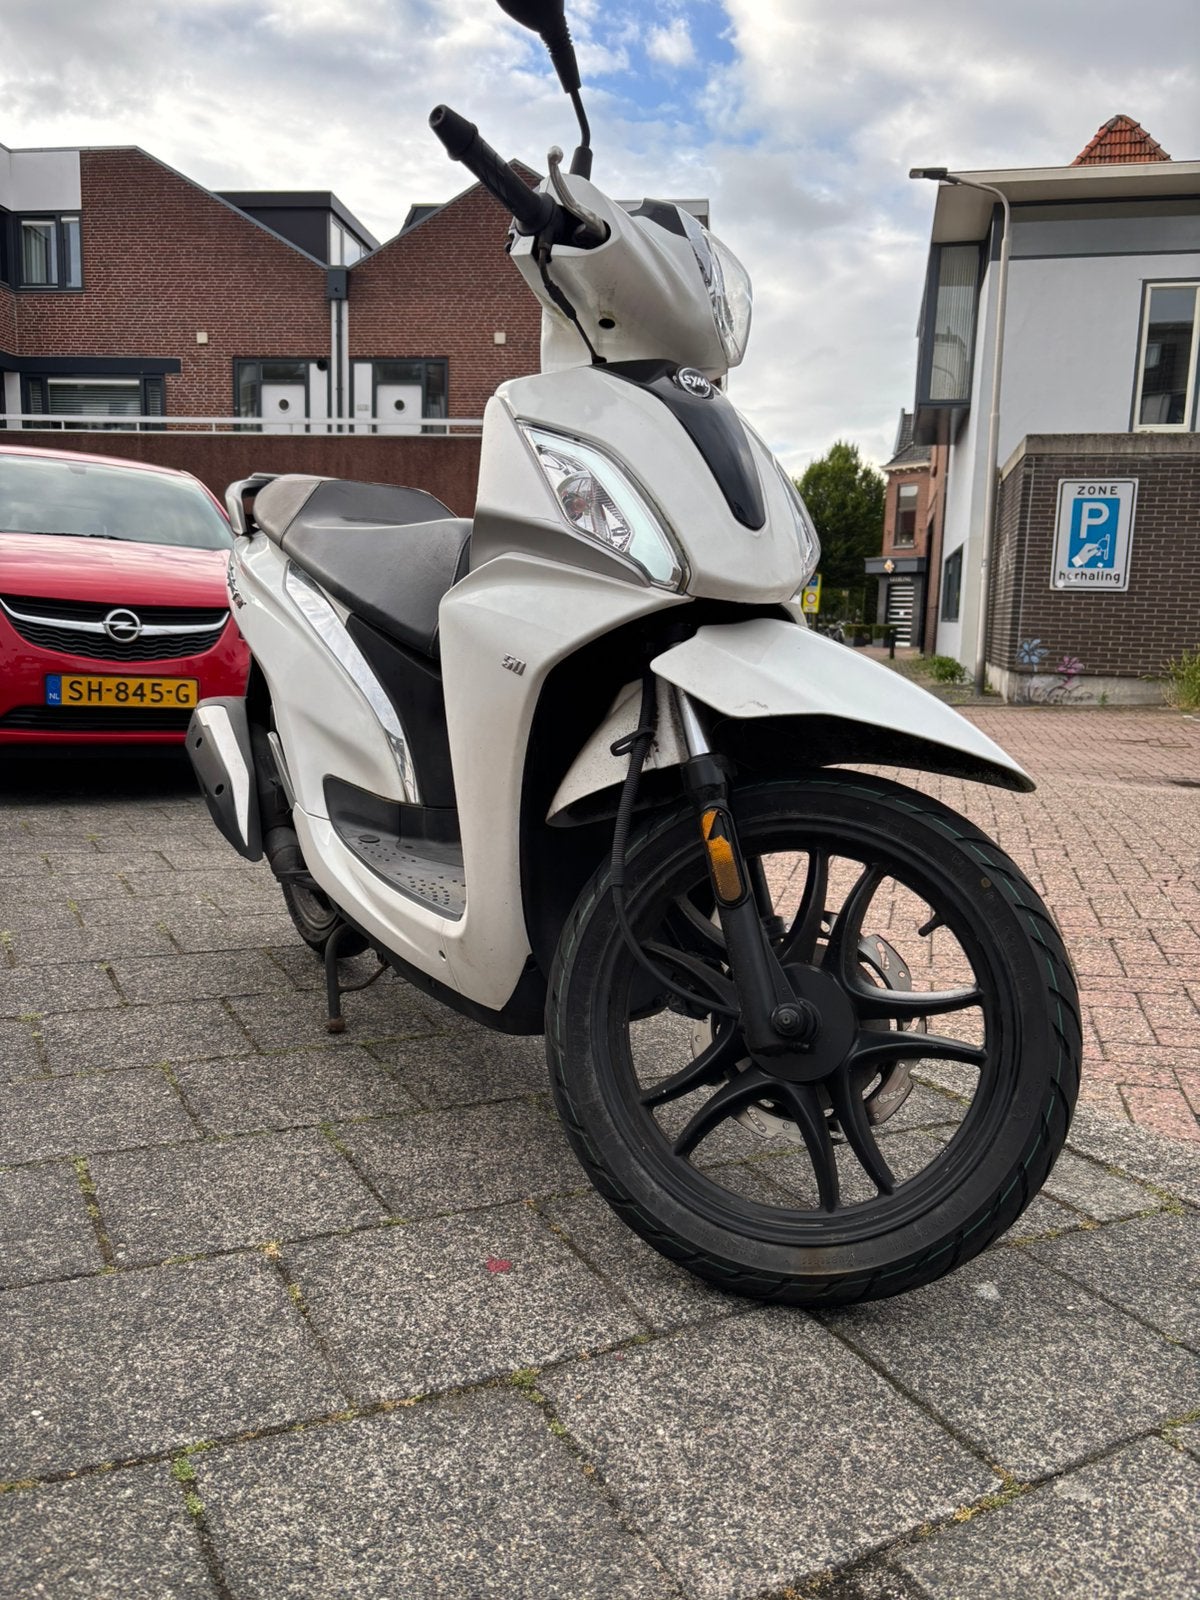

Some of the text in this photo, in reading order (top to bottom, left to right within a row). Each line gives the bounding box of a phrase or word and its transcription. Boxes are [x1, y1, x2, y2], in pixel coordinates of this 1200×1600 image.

[683, 374, 709, 388] SYM
[1077, 486, 1118, 496] ZONE
[1079, 501, 1110, 539] P
[49, 692, 60, 701] NL
[68, 680, 191, 704] SH-845-G
